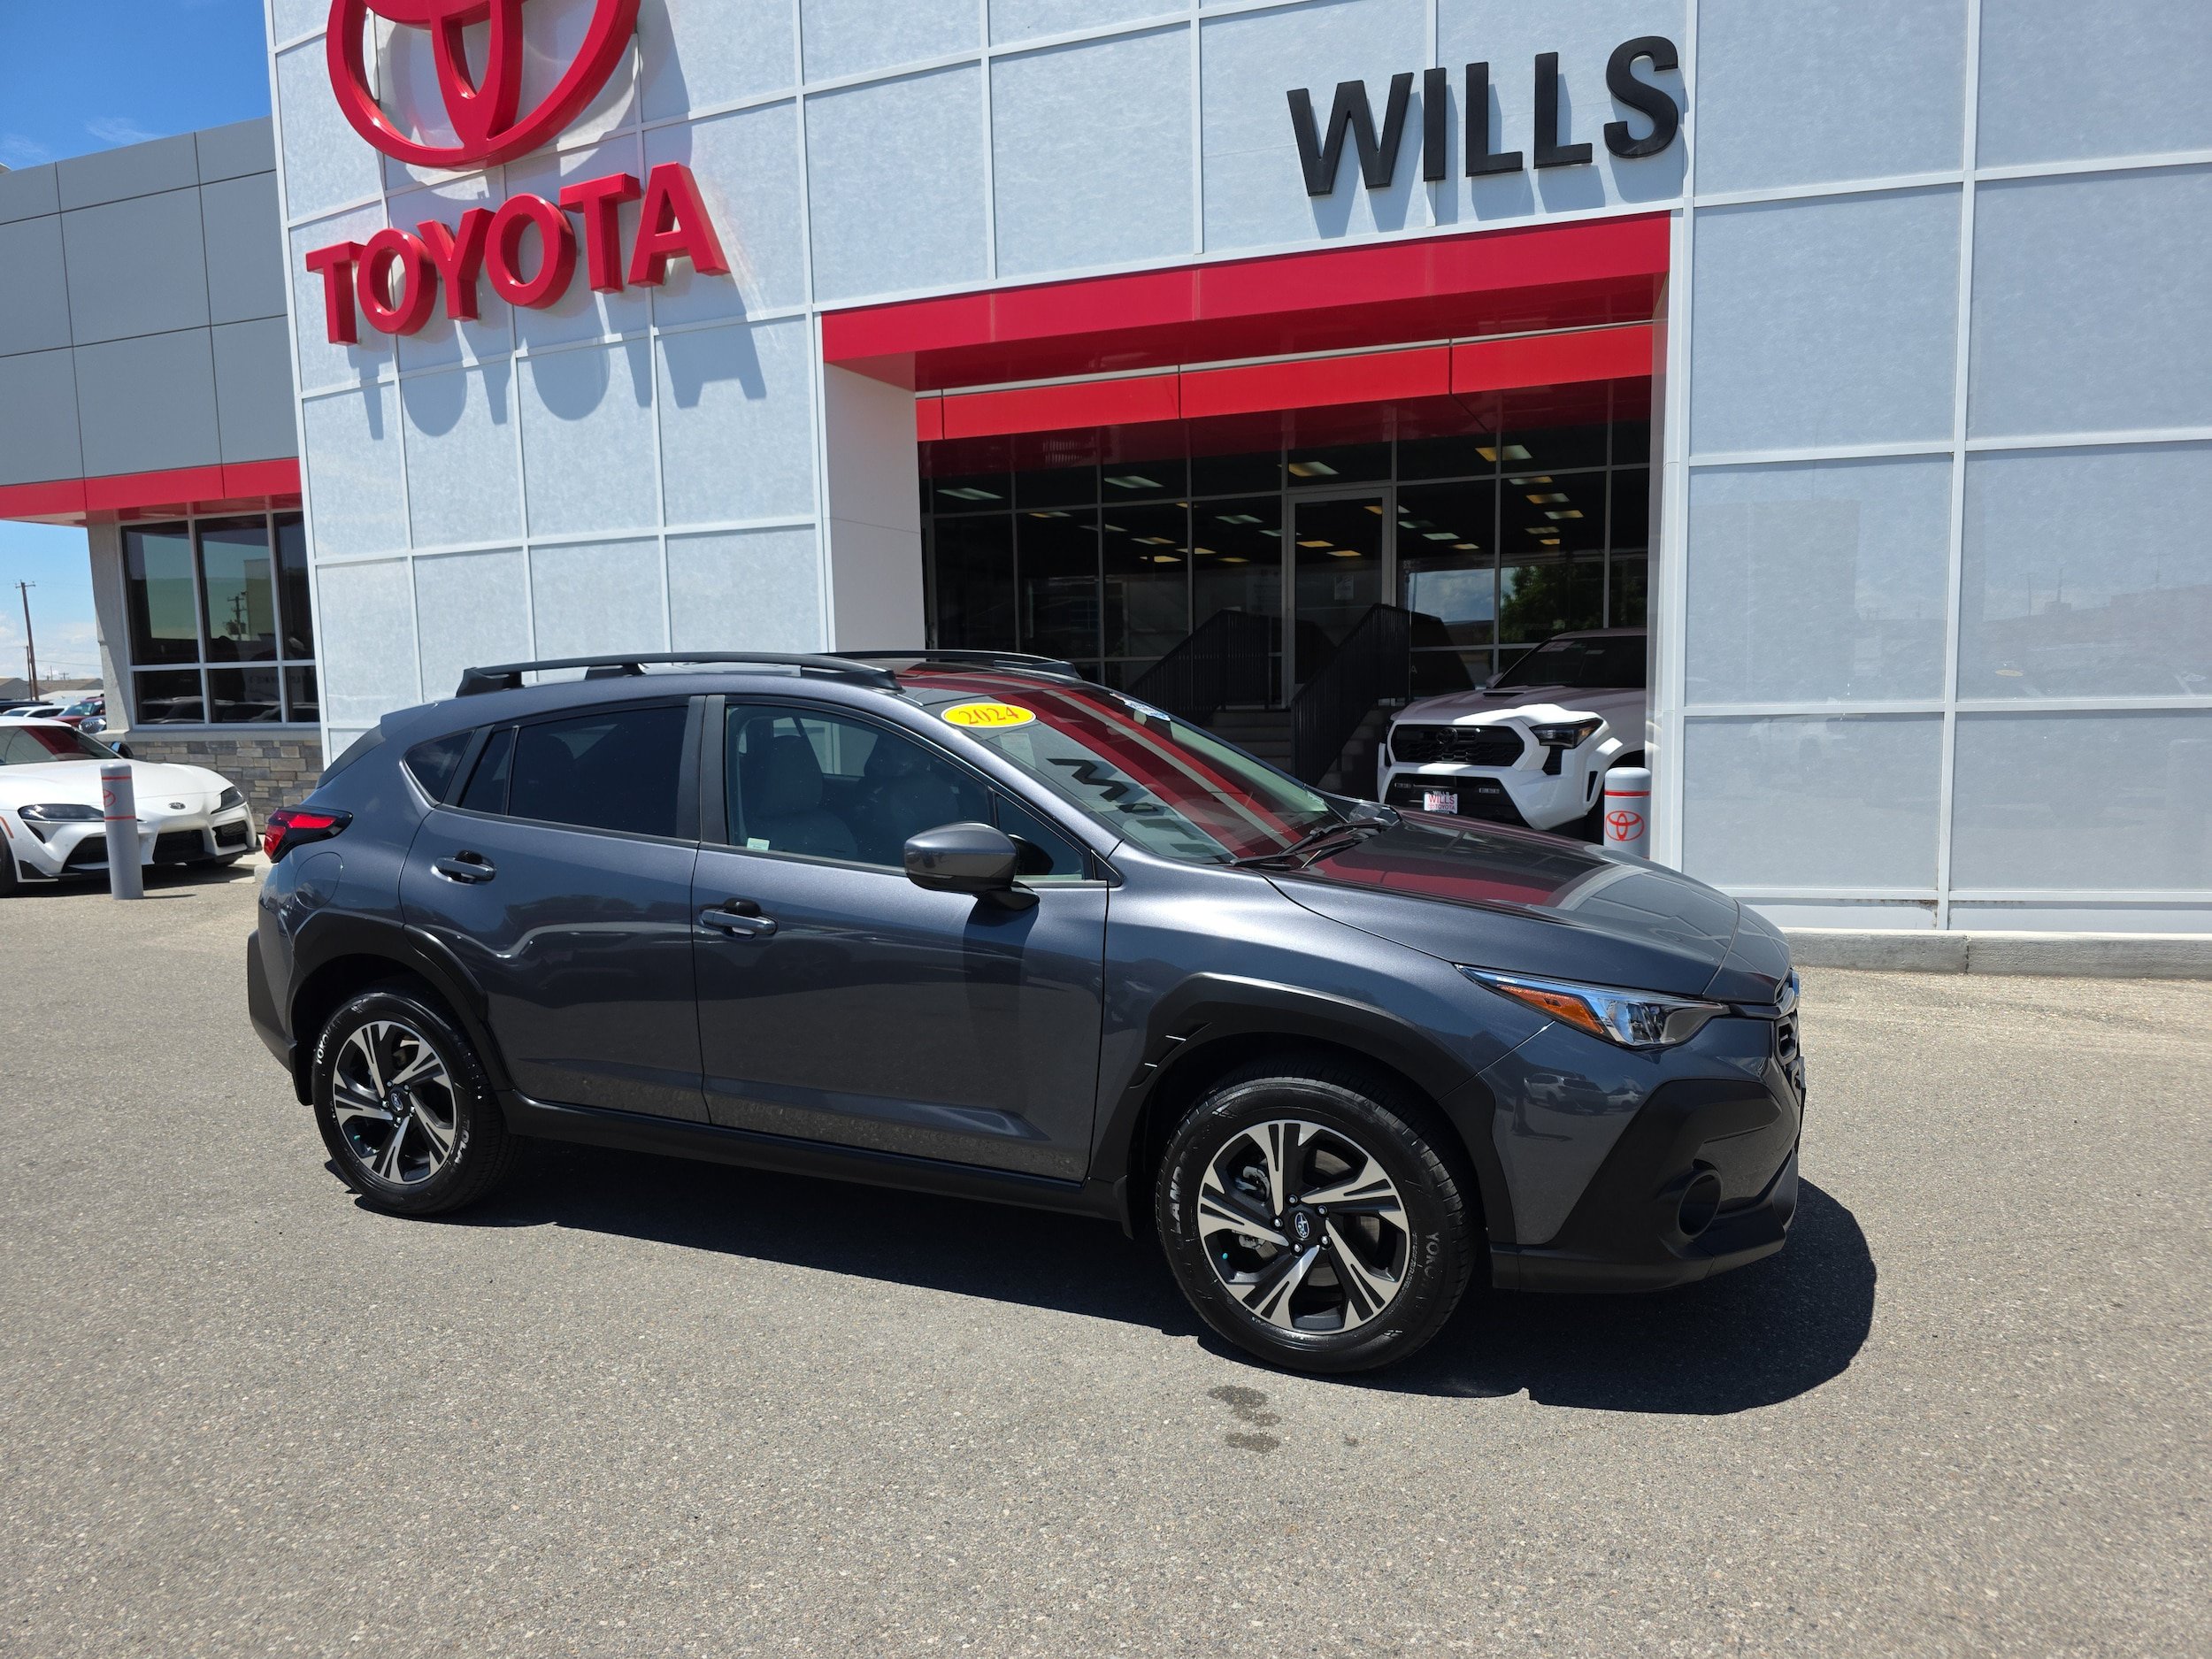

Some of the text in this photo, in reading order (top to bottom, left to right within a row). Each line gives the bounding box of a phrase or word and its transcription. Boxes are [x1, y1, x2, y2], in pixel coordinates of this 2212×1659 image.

[1286, 35, 1679, 197] WILLS
[306, 162, 731, 345] TOYOTA
[958, 706, 1019, 726] 2024
[1429, 795, 1455, 805] WILLS
